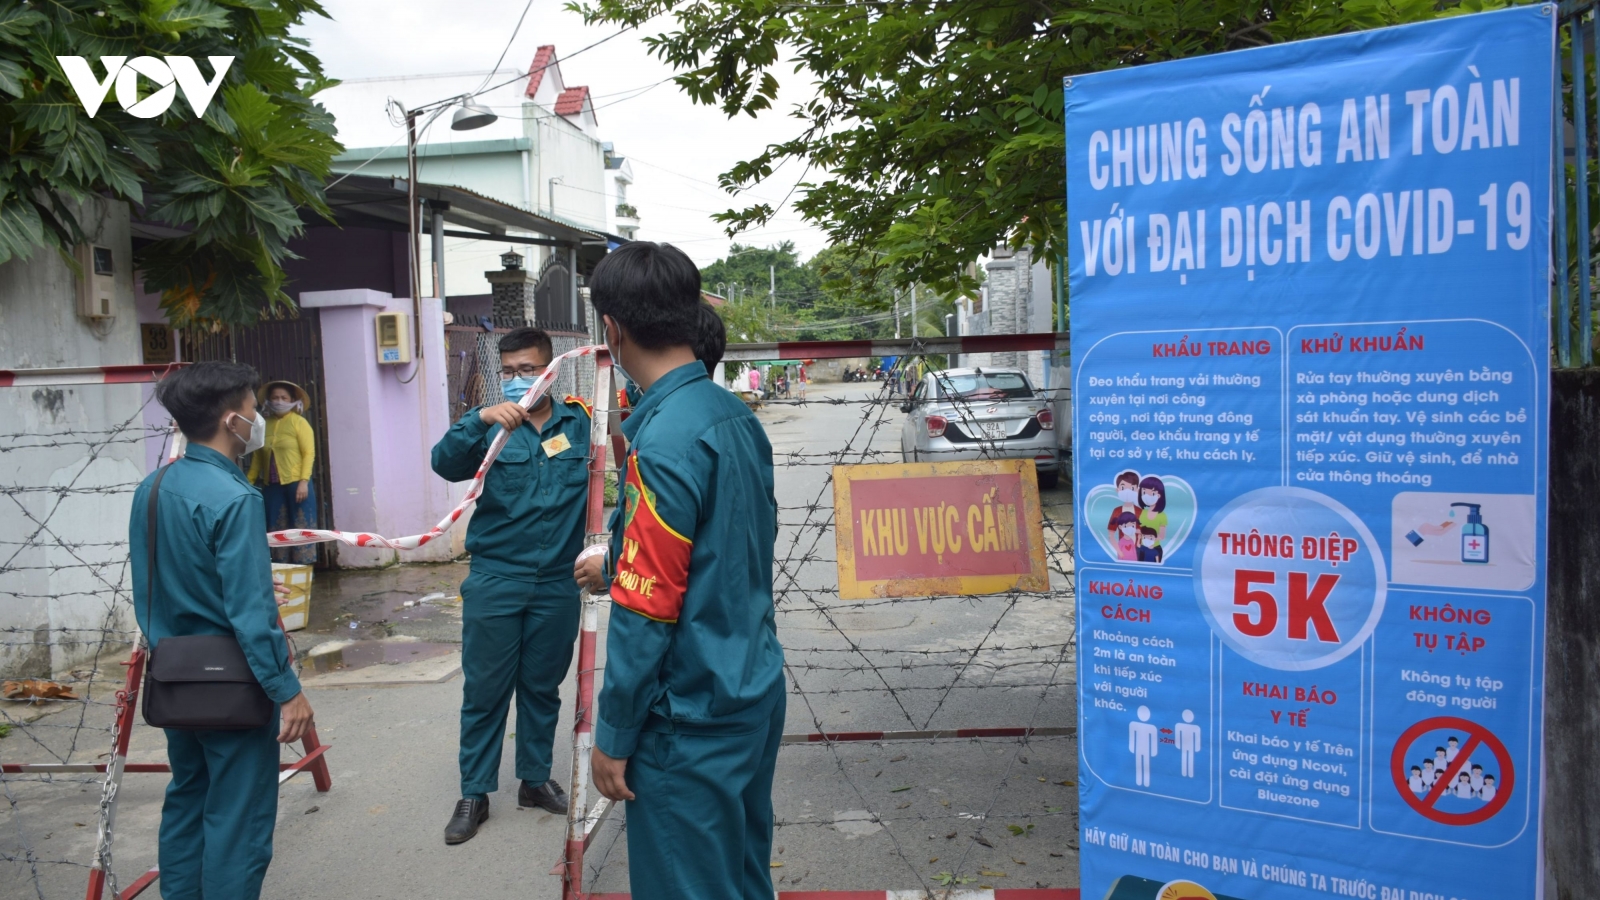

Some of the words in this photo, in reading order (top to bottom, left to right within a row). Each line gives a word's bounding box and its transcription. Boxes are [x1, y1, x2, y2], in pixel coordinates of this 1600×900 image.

[1089, 117, 1207, 190] CHUNG
[1221, 85, 1321, 176] SỐNG
[1336, 94, 1390, 163] AN
[1406, 65, 1519, 155] TOÀN
[1080, 203, 1135, 276] VỚI
[1147, 210, 1205, 285] ĐẠI
[1221, 200, 1310, 281] DỊCH
[1327, 182, 1530, 261] COVID-19
[149, 327, 167, 350] 33
[1153, 335, 1202, 357] KHẨU
[1208, 340, 1271, 356] TRANG
[1302, 333, 1344, 353] KHỬ
[1350, 327, 1424, 352] KHUẨN
[1089, 377, 1113, 386] Đeo
[1117, 373, 1147, 386] khẩu
[1150, 376, 1185, 388] trang
[1189, 373, 1209, 385] vải
[1213, 373, 1260, 387] thường
[1297, 371, 1324, 384] Rửa
[1329, 372, 1352, 385] tay
[1357, 371, 1410, 385] thường
[1416, 369, 1464, 384] xuyên
[1469, 366, 1512, 384] bằng
[1090, 394, 1125, 406] xuyên
[1129, 394, 1145, 407] tại
[1149, 394, 1168, 404] nơi
[1172, 393, 1206, 407] công
[1297, 392, 1315, 403] xà
[1320, 391, 1367, 406] phòng
[1372, 391, 1411, 405] hoặc
[1417, 391, 1458, 405] dung
[1463, 390, 1499, 405] dịch
[986, 422, 1000, 431] 92A
[1089, 411, 1120, 425] cộng
[1131, 412, 1150, 422] nơi
[1154, 411, 1175, 425] tập
[1179, 412, 1213, 425] trung
[1217, 411, 1253, 425] đông
[1296, 411, 1318, 422] sát
[1323, 408, 1368, 422] khuẩn
[1373, 412, 1400, 425] tay.
[1406, 411, 1426, 426] Vệ
[1432, 412, 1463, 423] sinh
[1468, 410, 1500, 423] các
[1506, 408, 1527, 422] bề
[1090, 429, 1127, 443] người,
[1131, 430, 1155, 440] đeo
[1159, 427, 1191, 441] khẩu
[1195, 431, 1230, 444] trang
[1234, 433, 1242, 444] y
[1245, 429, 1260, 441] tế
[1297, 431, 1332, 445] mặt/
[1338, 431, 1362, 445] vật
[1366, 432, 1406, 446] dụng
[1410, 431, 1466, 446] thường
[1472, 431, 1521, 446] xuyên
[1090, 447, 1105, 460] tại
[1109, 449, 1125, 458] cơ
[1128, 446, 1142, 458] sở
[1145, 450, 1152, 460] y
[1156, 446, 1172, 460] tế,
[1176, 449, 1199, 459] khu
[1203, 448, 1237, 460] cách
[1242, 450, 1255, 462] ly.
[1296, 449, 1324, 464] tiếp
[1329, 450, 1360, 462] xúc.
[1366, 451, 1393, 463] Giữ
[1396, 451, 1415, 466] vệ
[1420, 452, 1456, 465] sinh,
[1461, 449, 1482, 464] để
[1488, 452, 1518, 464] nhà
[1297, 469, 1324, 481] cửa
[1329, 470, 1372, 485] thông
[1376, 471, 1432, 487] thoáng
[860, 508, 909, 557] KHU
[913, 500, 962, 565] VỰC
[967, 486, 1020, 554] CẤM
[1217, 528, 1294, 559] THÔNG
[1300, 530, 1358, 567] ĐIỆP
[639, 575, 657, 599] VỆ
[1089, 580, 1163, 600] KHOẢNG
[1101, 604, 1151, 623] CÁCH
[1231, 568, 1342, 644] 5K
[1410, 604, 1491, 625] KHÔNG
[1094, 630, 1139, 647] Khoảng
[1142, 636, 1174, 648] cách
[1414, 633, 1438, 652] TỤ
[1445, 632, 1486, 655] TẬP
[1094, 647, 1111, 658] 2m
[1114, 649, 1125, 660] là
[1129, 654, 1144, 662] an
[1148, 654, 1176, 666] toàn
[1094, 664, 1110, 675] khi
[1114, 666, 1136, 680] tiếp
[1140, 671, 1162, 682] xúc
[1402, 670, 1450, 688] Không
[1455, 675, 1471, 689] tụ
[1476, 676, 1503, 691] tập
[1094, 681, 1111, 692] với
[1115, 686, 1147, 698] người
[1243, 682, 1288, 700] KHAI
[1295, 686, 1337, 705] BÁO
[1095, 698, 1126, 711] khác.
[1406, 690, 1446, 707] đông
[1452, 697, 1496, 710] người
[1271, 710, 1282, 724] Y
[1288, 708, 1310, 728] TẾ
[1228, 731, 1257, 744] Khai
[1262, 735, 1289, 748] báo
[1293, 741, 1301, 752] y
[1305, 740, 1320, 752] tế
[1323, 743, 1353, 756] Trên
[1233, 749, 1258, 765] ứng
[1262, 754, 1297, 770] dụng
[1302, 759, 1346, 776] Ncovi,
[1230, 767, 1250, 779] cài
[1255, 771, 1278, 785] đặt
[1283, 774, 1308, 790] ứng
[1313, 780, 1350, 796] dụng
[1258, 789, 1319, 808] Bluezone
[1085, 827, 1106, 845] HÃY
[1109, 833, 1128, 851] GIỮ
[1132, 839, 1146, 855] AN
[1150, 842, 1179, 862] TOÀN
[1184, 850, 1209, 868] CHO
[1213, 855, 1237, 873] BẠN
[1242, 858, 1258, 877] VÀ
[1262, 864, 1306, 887] CHÚNG
[1311, 873, 1326, 891] TA
[1331, 877, 1376, 900] TRƯỚC
